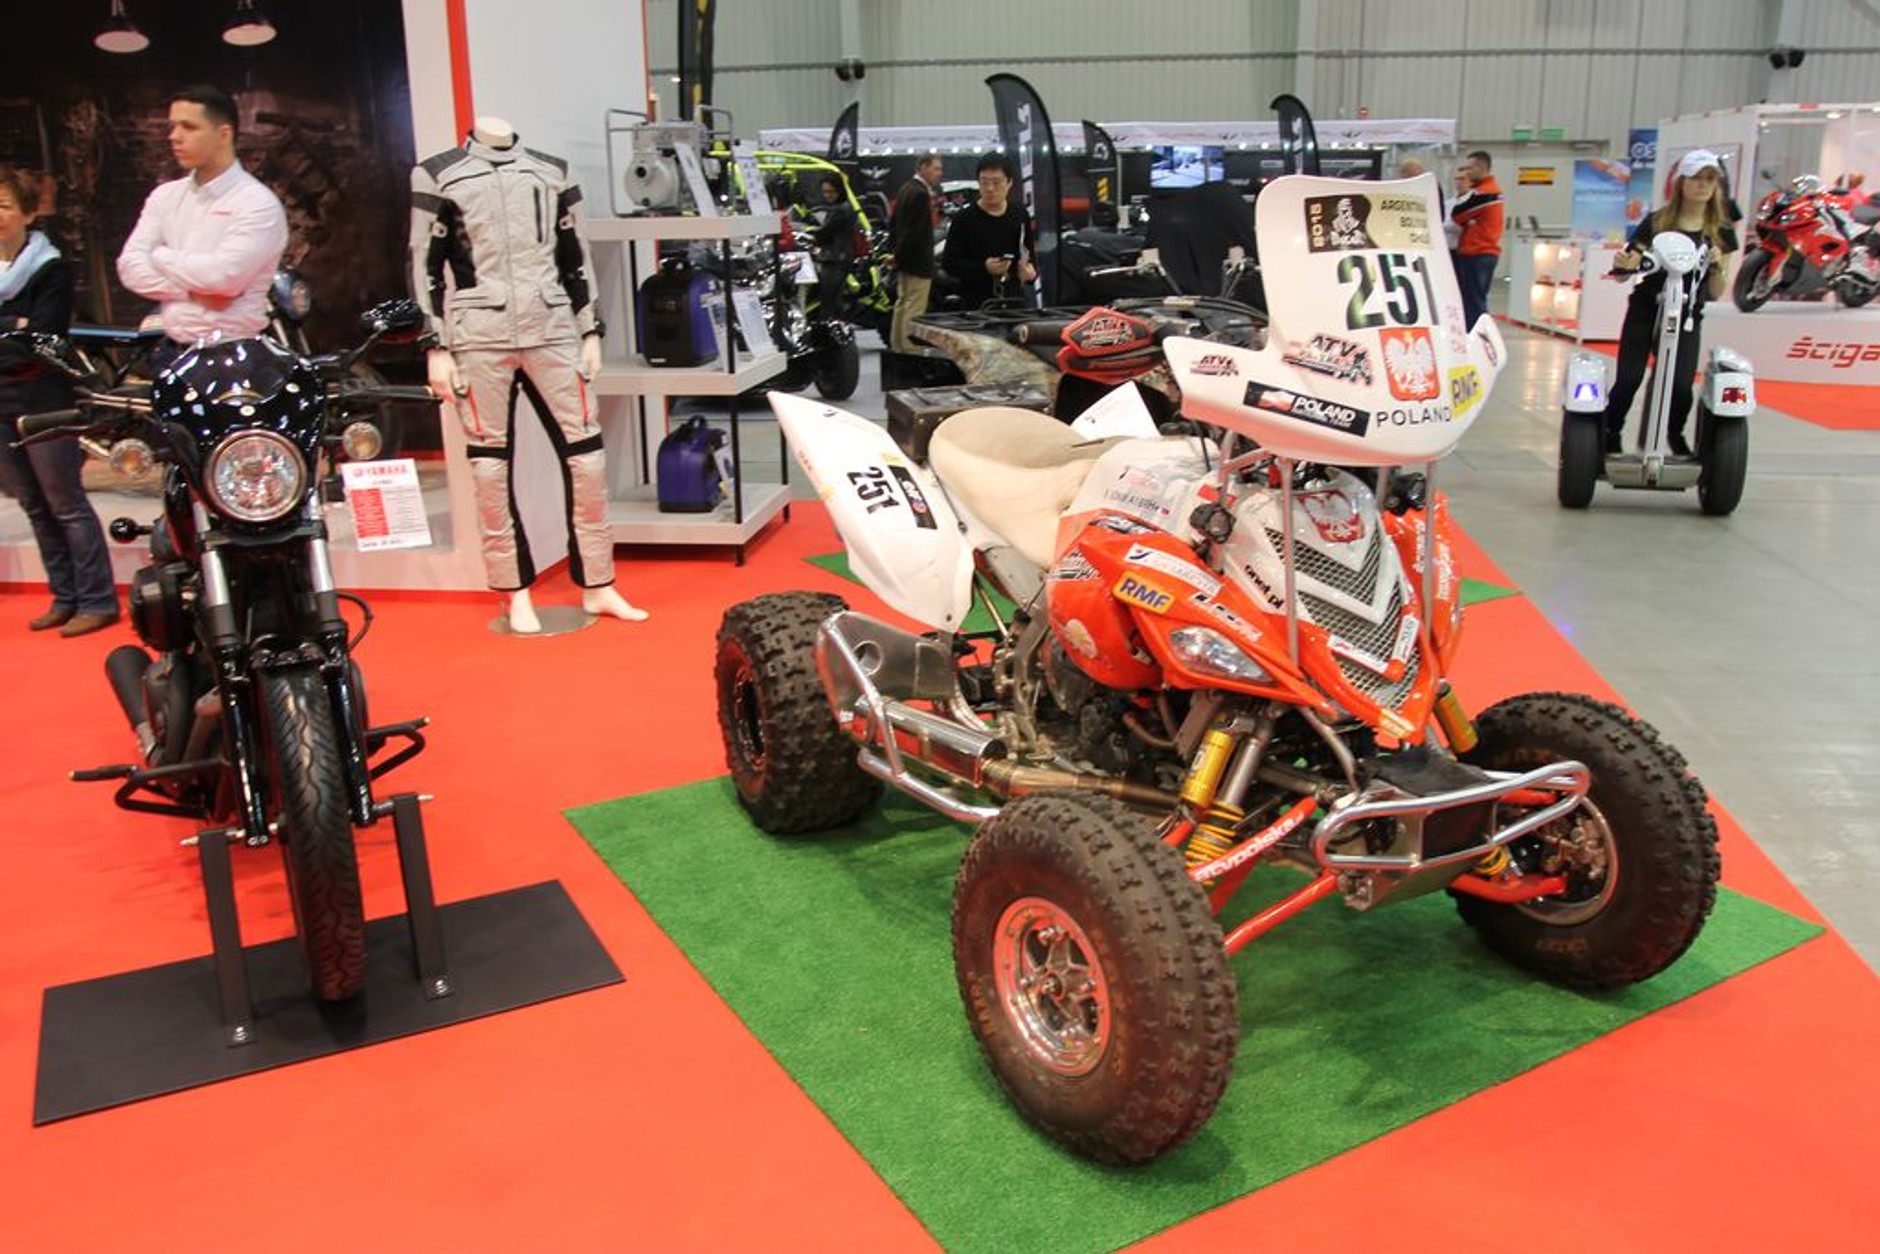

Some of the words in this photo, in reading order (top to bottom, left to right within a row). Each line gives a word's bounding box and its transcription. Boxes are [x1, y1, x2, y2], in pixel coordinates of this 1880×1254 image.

[1309, 203, 1325, 248] 2015
[1337, 253, 1440, 331] 251
[1311, 335, 1357, 358] ATV
[1452, 370, 1478, 408] RMF
[1293, 396, 1356, 422] POLAND
[1376, 406, 1453, 427] POLAND
[847, 466, 899, 515] 251
[1119, 576, 1170, 609] RMF
[1244, 564, 1285, 609] onet.pl
